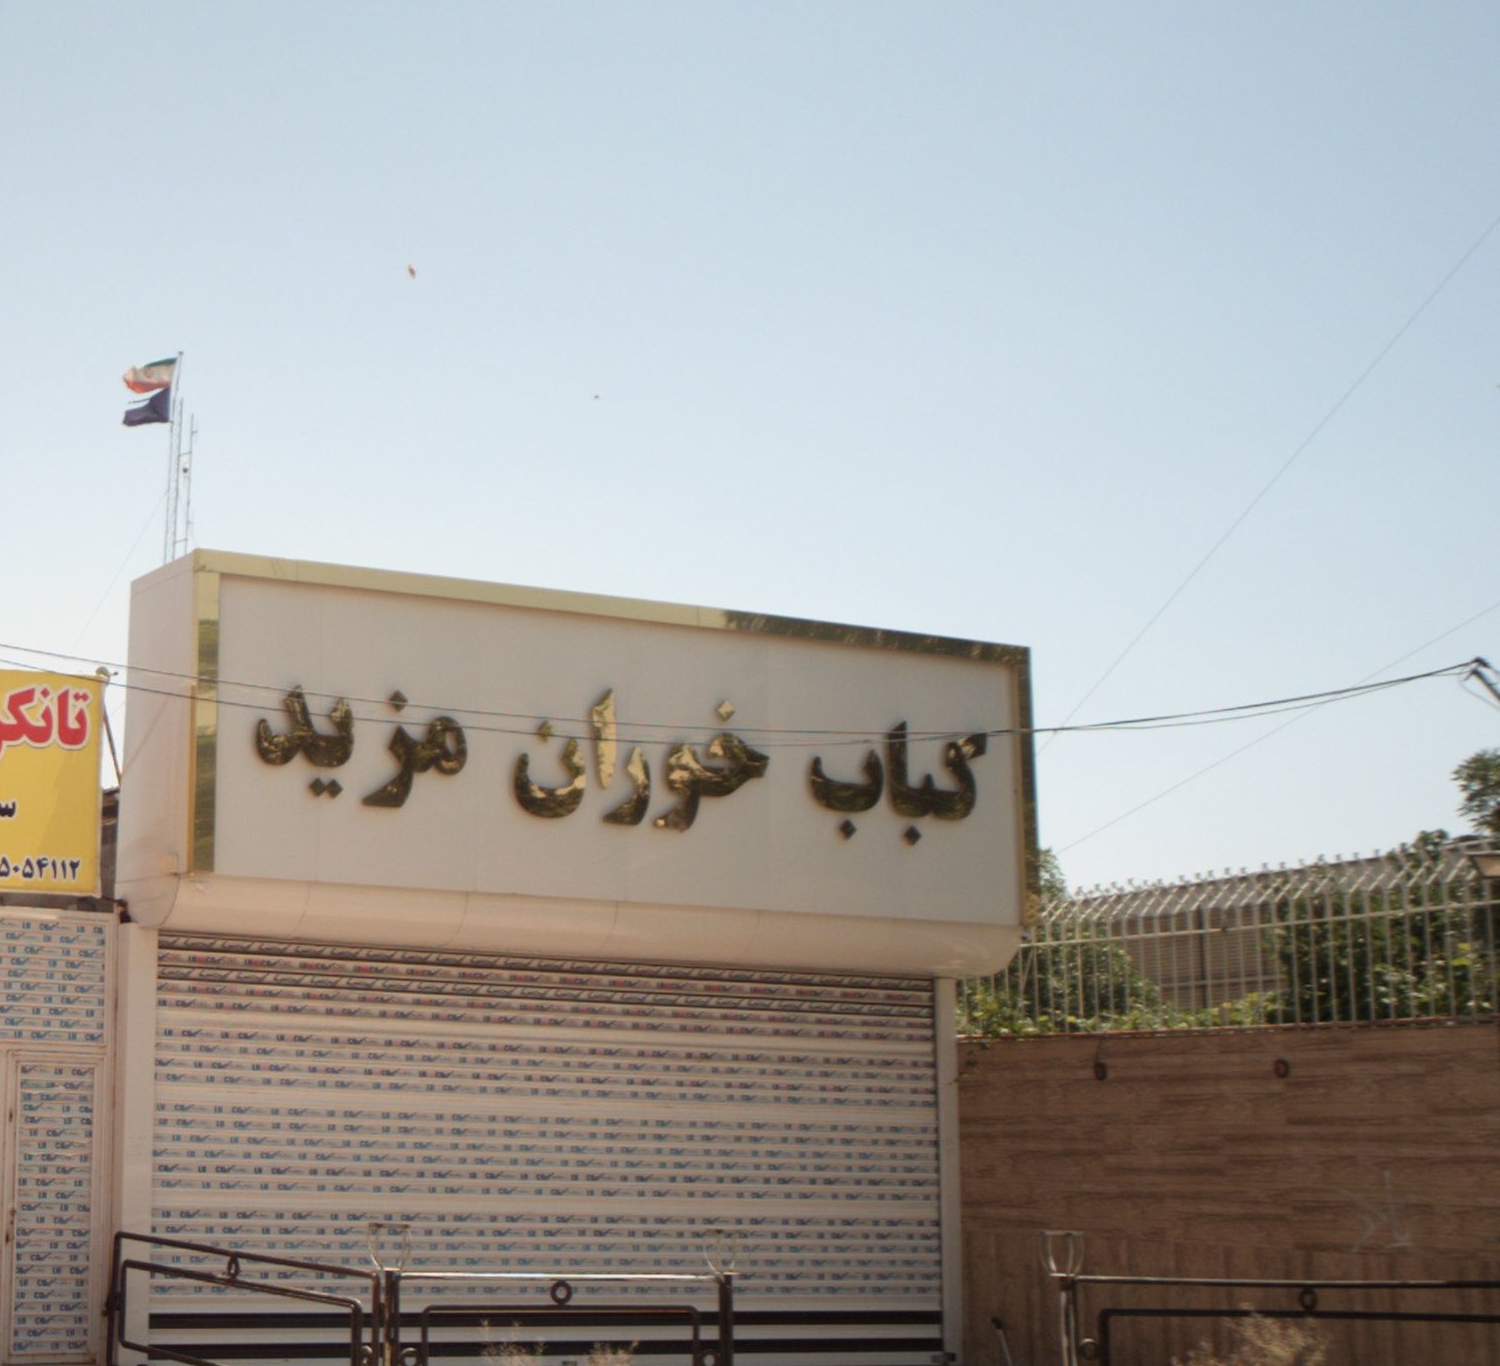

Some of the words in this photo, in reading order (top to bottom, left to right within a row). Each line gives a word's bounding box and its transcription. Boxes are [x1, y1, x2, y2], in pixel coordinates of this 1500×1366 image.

[254, 684, 469, 809] مزید
[513, 687, 771, 832] خوران
[810, 721, 988, 846] کباب
